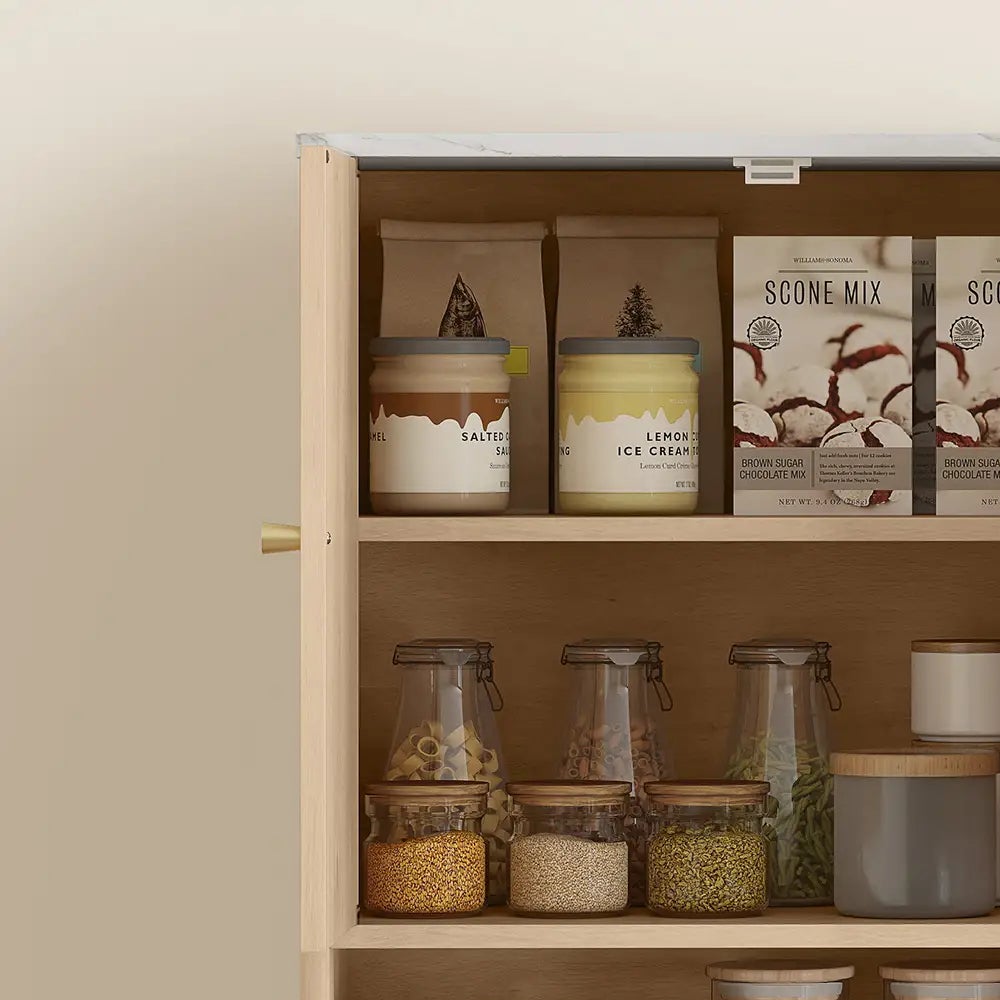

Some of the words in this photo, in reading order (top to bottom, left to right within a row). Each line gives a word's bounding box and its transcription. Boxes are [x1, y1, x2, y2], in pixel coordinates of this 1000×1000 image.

[765, 280, 833, 305] SCONE
[845, 280, 881, 305] MIX
[462, 431, 504, 442] SALTED
[646, 431, 689, 442] LEMON
[617, 446, 641, 456] ICE
[649, 446, 690, 456] CREAM
[741, 458, 773, 468] BROWN
[775, 458, 804, 468] SUGAR
[944, 458, 976, 468] BROWN
[739, 469, 788, 480] CHOCOLATE
[790, 469, 806, 480] MIX
[941, 469, 991, 480] CHOCOLATE
[778, 498, 796, 506] NET
[815, 498, 828, 506] 9.4
[829, 498, 841, 506] OZ
[981, 498, 999, 506] NET
